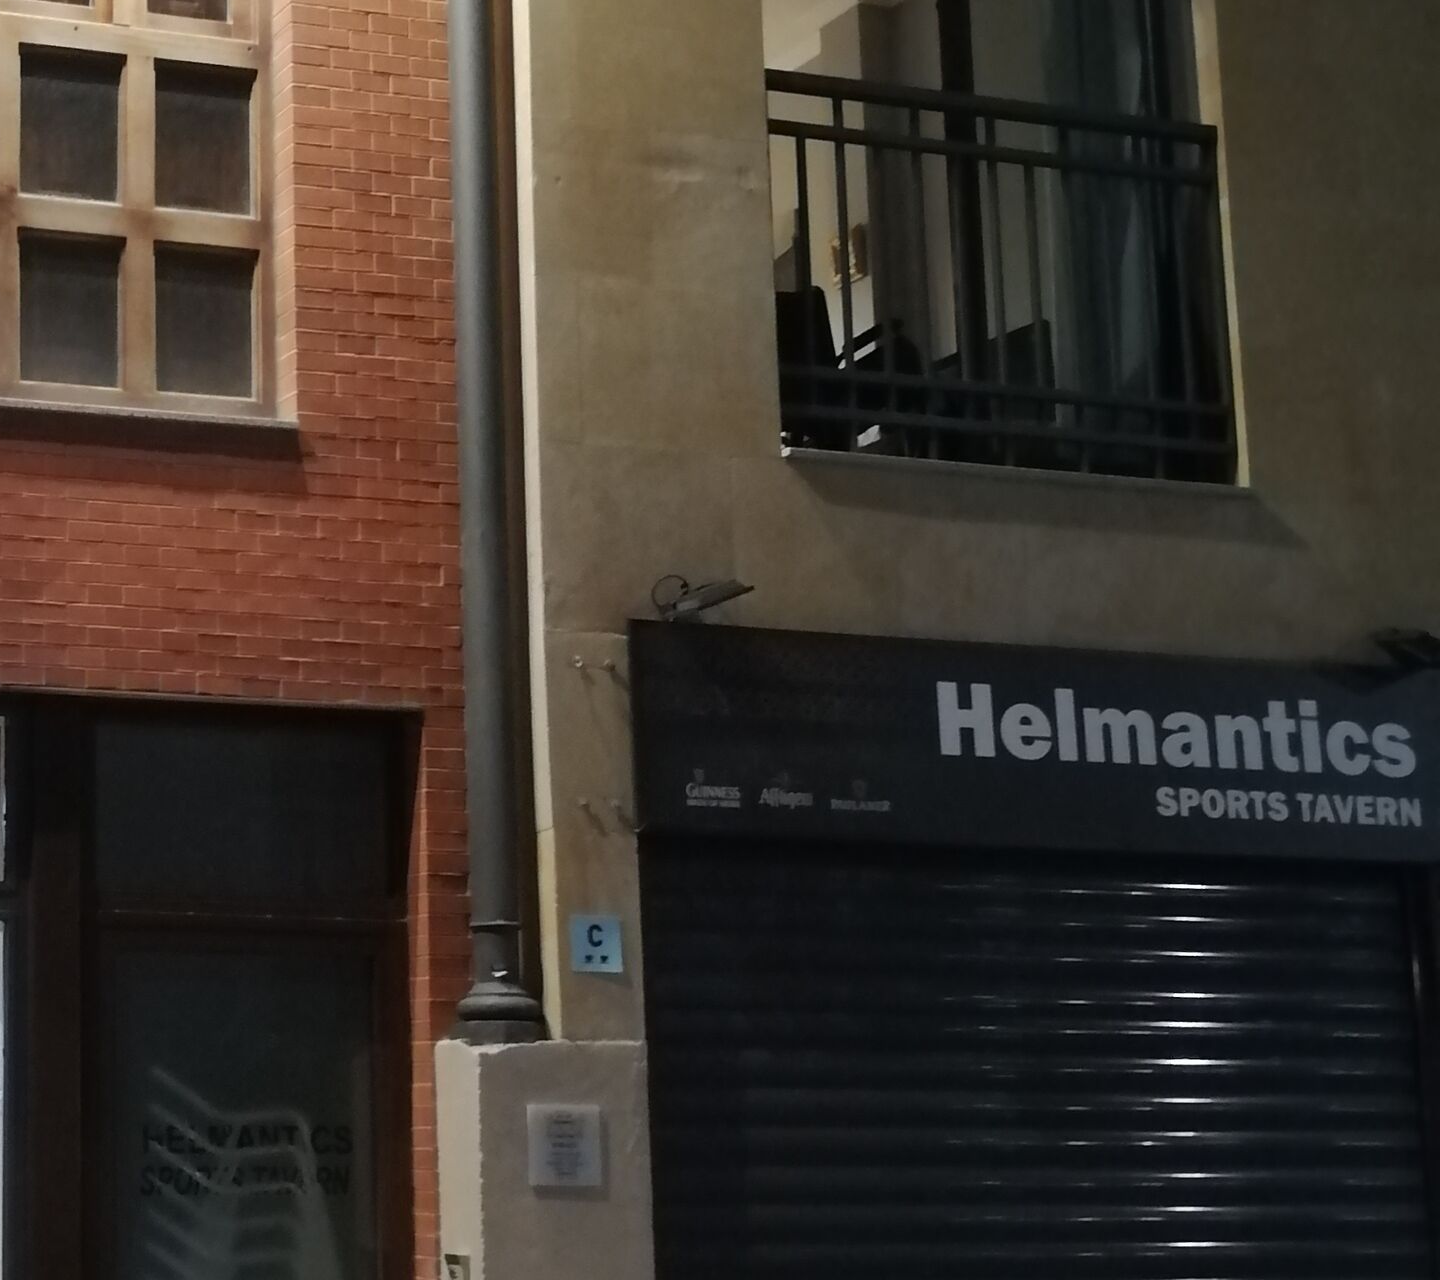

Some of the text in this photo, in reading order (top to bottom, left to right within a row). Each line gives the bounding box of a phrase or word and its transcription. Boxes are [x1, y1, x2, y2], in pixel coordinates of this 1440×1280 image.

[935, 680, 1417, 780] Helmantics
[685, 782, 741, 800] GUINNESS
[1155, 786, 1423, 828] SPORTS TAVERN
[587, 924, 603, 947] C
[142, 1123, 353, 1155] HELMANTCS
